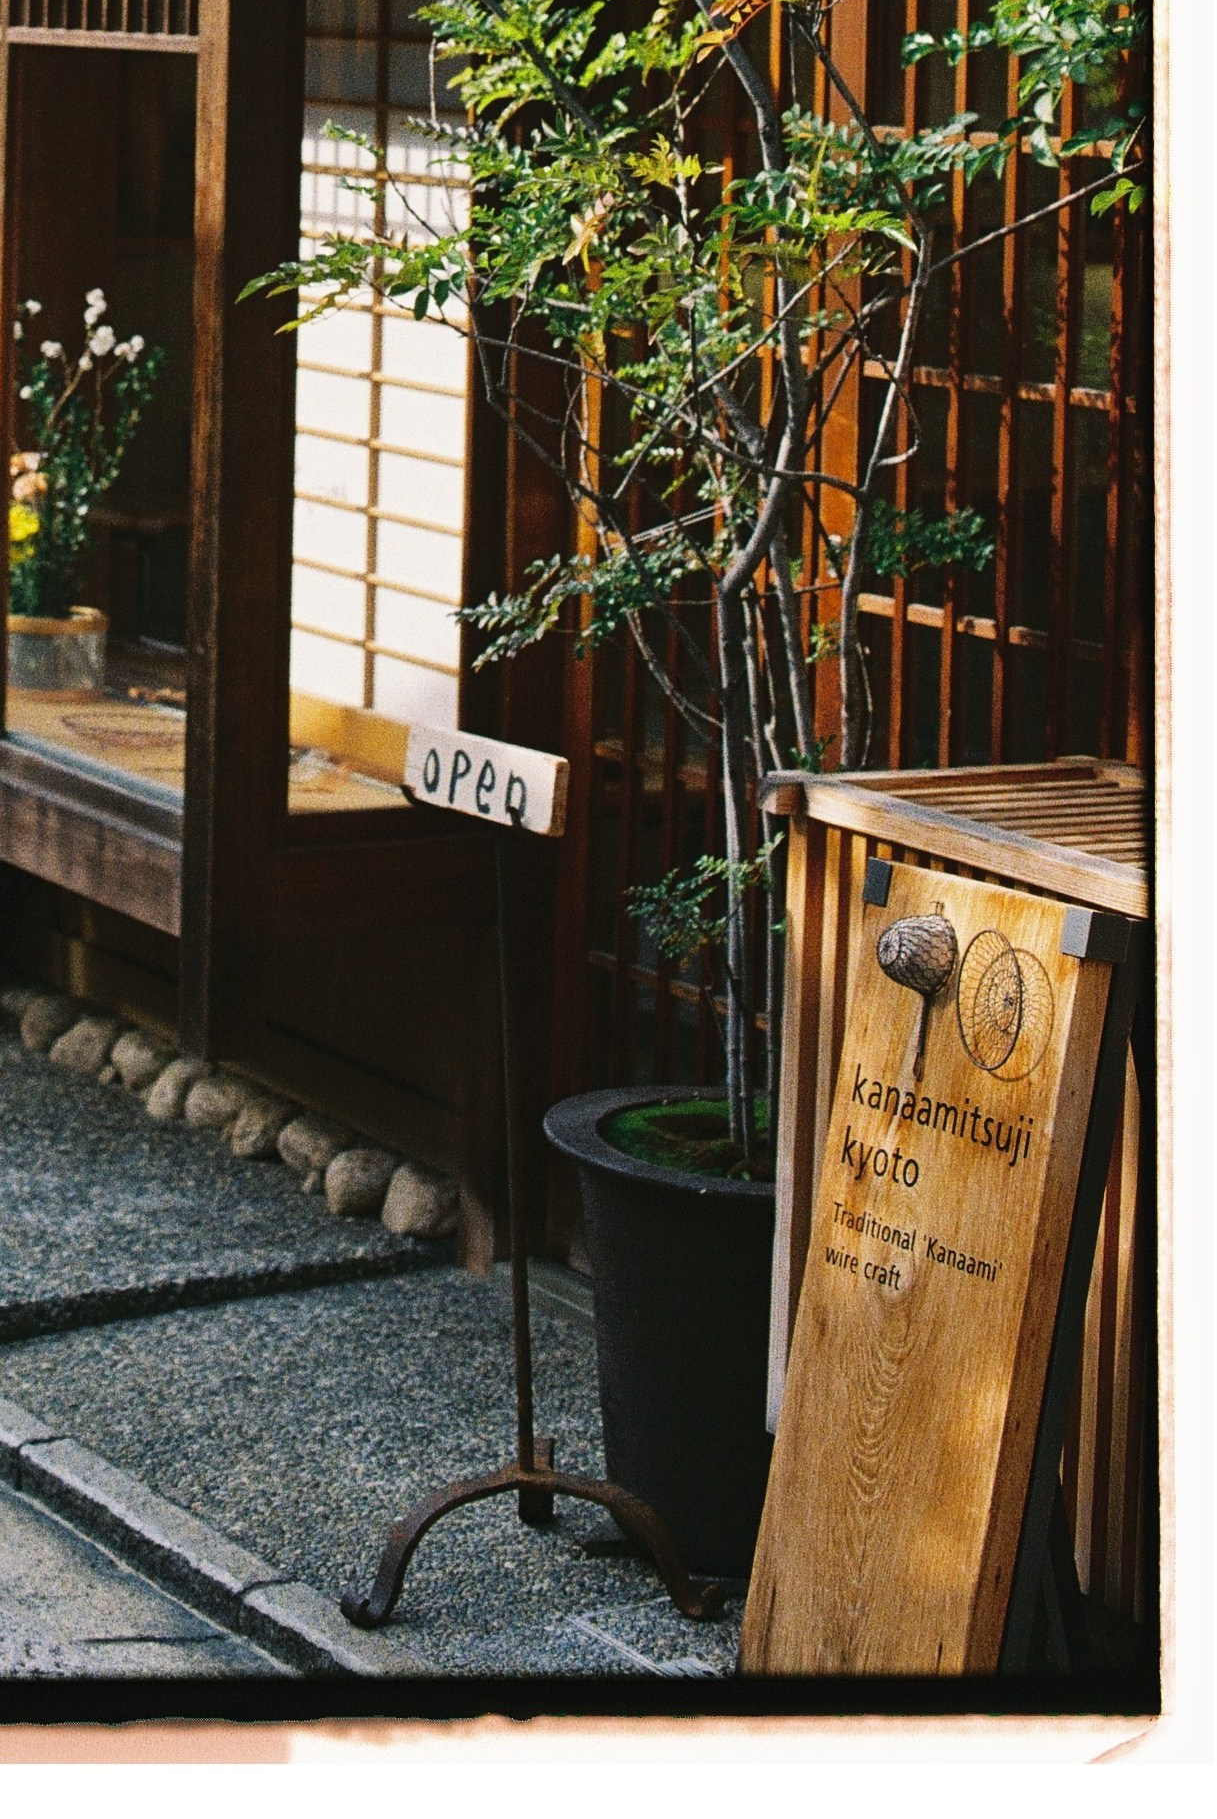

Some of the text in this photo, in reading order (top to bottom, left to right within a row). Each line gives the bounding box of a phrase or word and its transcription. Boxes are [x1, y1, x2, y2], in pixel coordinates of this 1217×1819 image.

[851, 1063, 1035, 1168] kanaamitsuji
[840, 1126, 920, 1188] kyoto
[824, 1247, 902, 1291] wire craft
[833, 1202, 1004, 1283] Traditional 'Kanaami'
